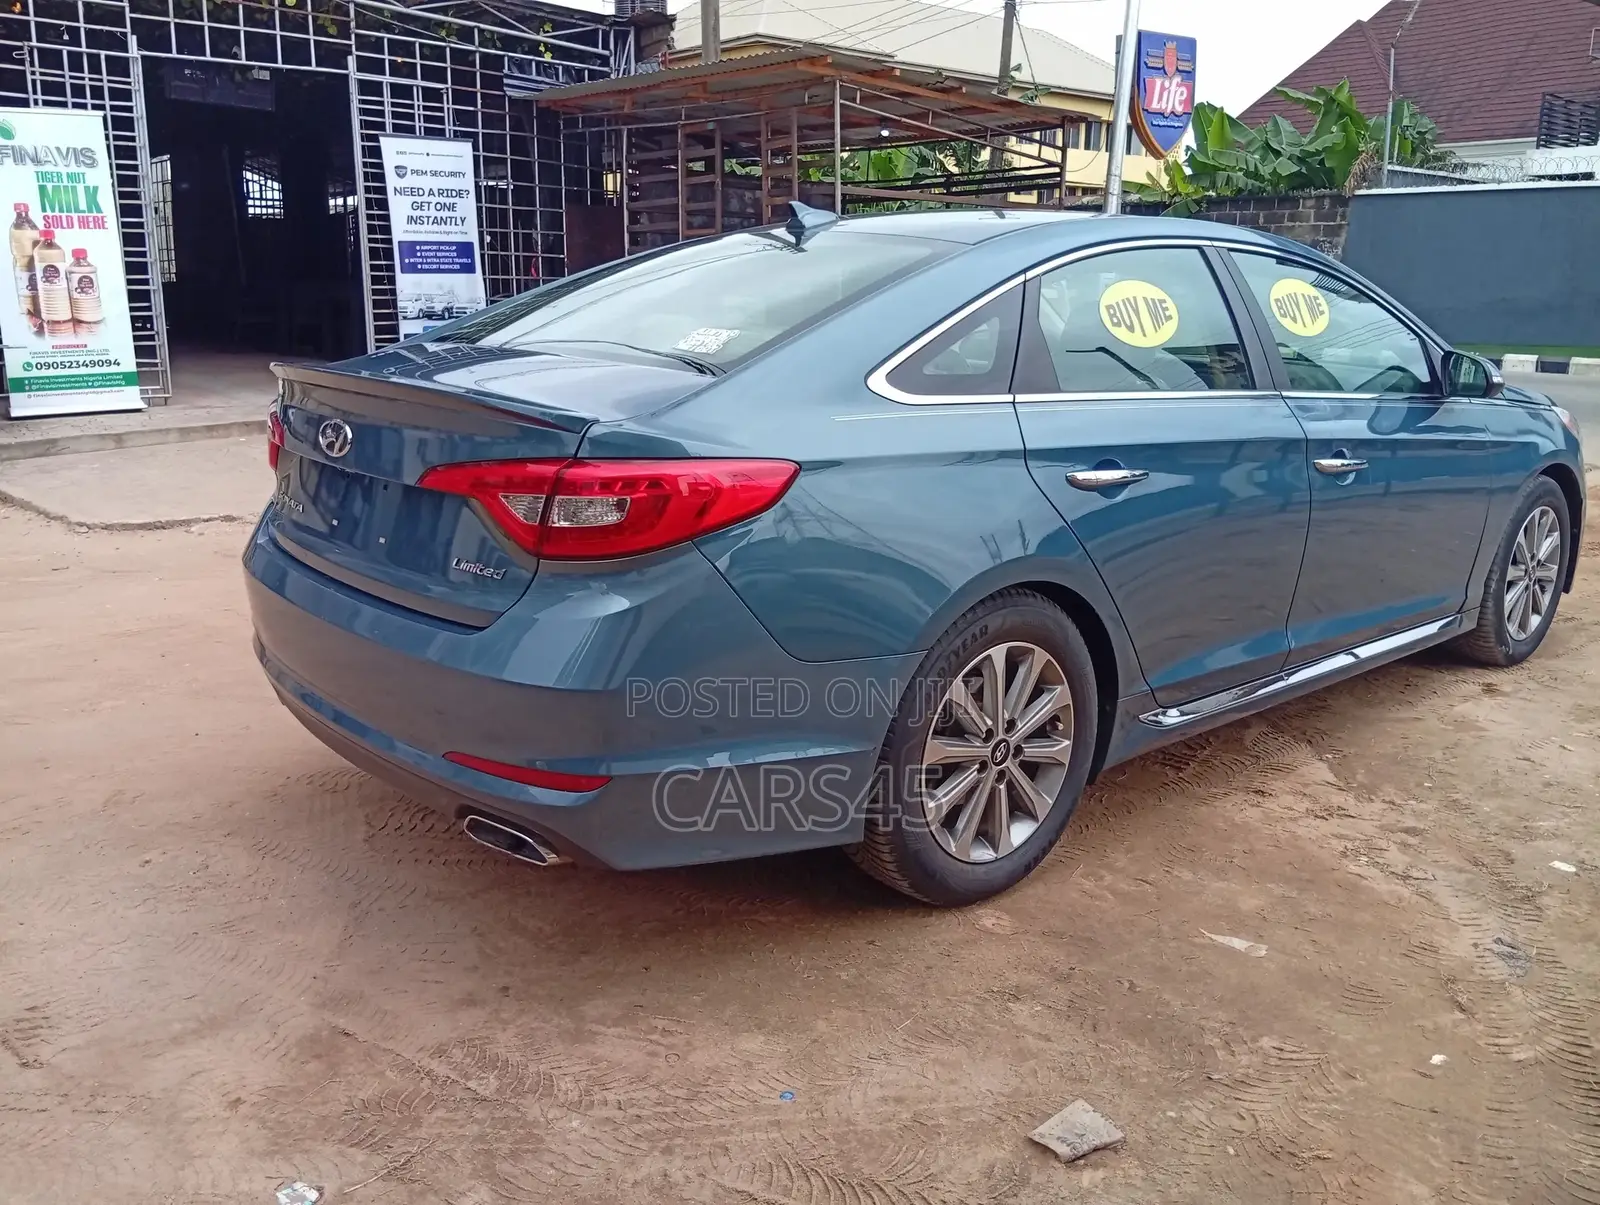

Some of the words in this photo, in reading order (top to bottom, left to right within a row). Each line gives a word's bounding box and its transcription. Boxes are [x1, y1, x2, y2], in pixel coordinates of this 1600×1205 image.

[1151, 75, 1188, 113] Life
[0, 145, 99, 168] FINAVIS
[34, 170, 64, 184] TIGER
[66, 171, 86, 184] NUT
[410, 169, 428, 177] PEM
[429, 170, 466, 179] SECURITY
[37, 184, 104, 214] MILK
[393, 186, 425, 197] NEED
[427, 188, 436, 198] A
[437, 188, 470, 199] RIDE?
[411, 201, 432, 212] GET
[434, 201, 458, 212] ONE
[42, 215, 74, 229] SOLD
[77, 215, 108, 230] HERE
[406, 215, 467, 227] INSTANTLY
[1104, 295, 1147, 338] BUY
[1142, 296, 1173, 333] ME
[1274, 291, 1307, 328] BUY
[1301, 292, 1325, 326] ME
[35, 359, 121, 371] 09052349094
[452, 557, 507, 580] Limited
